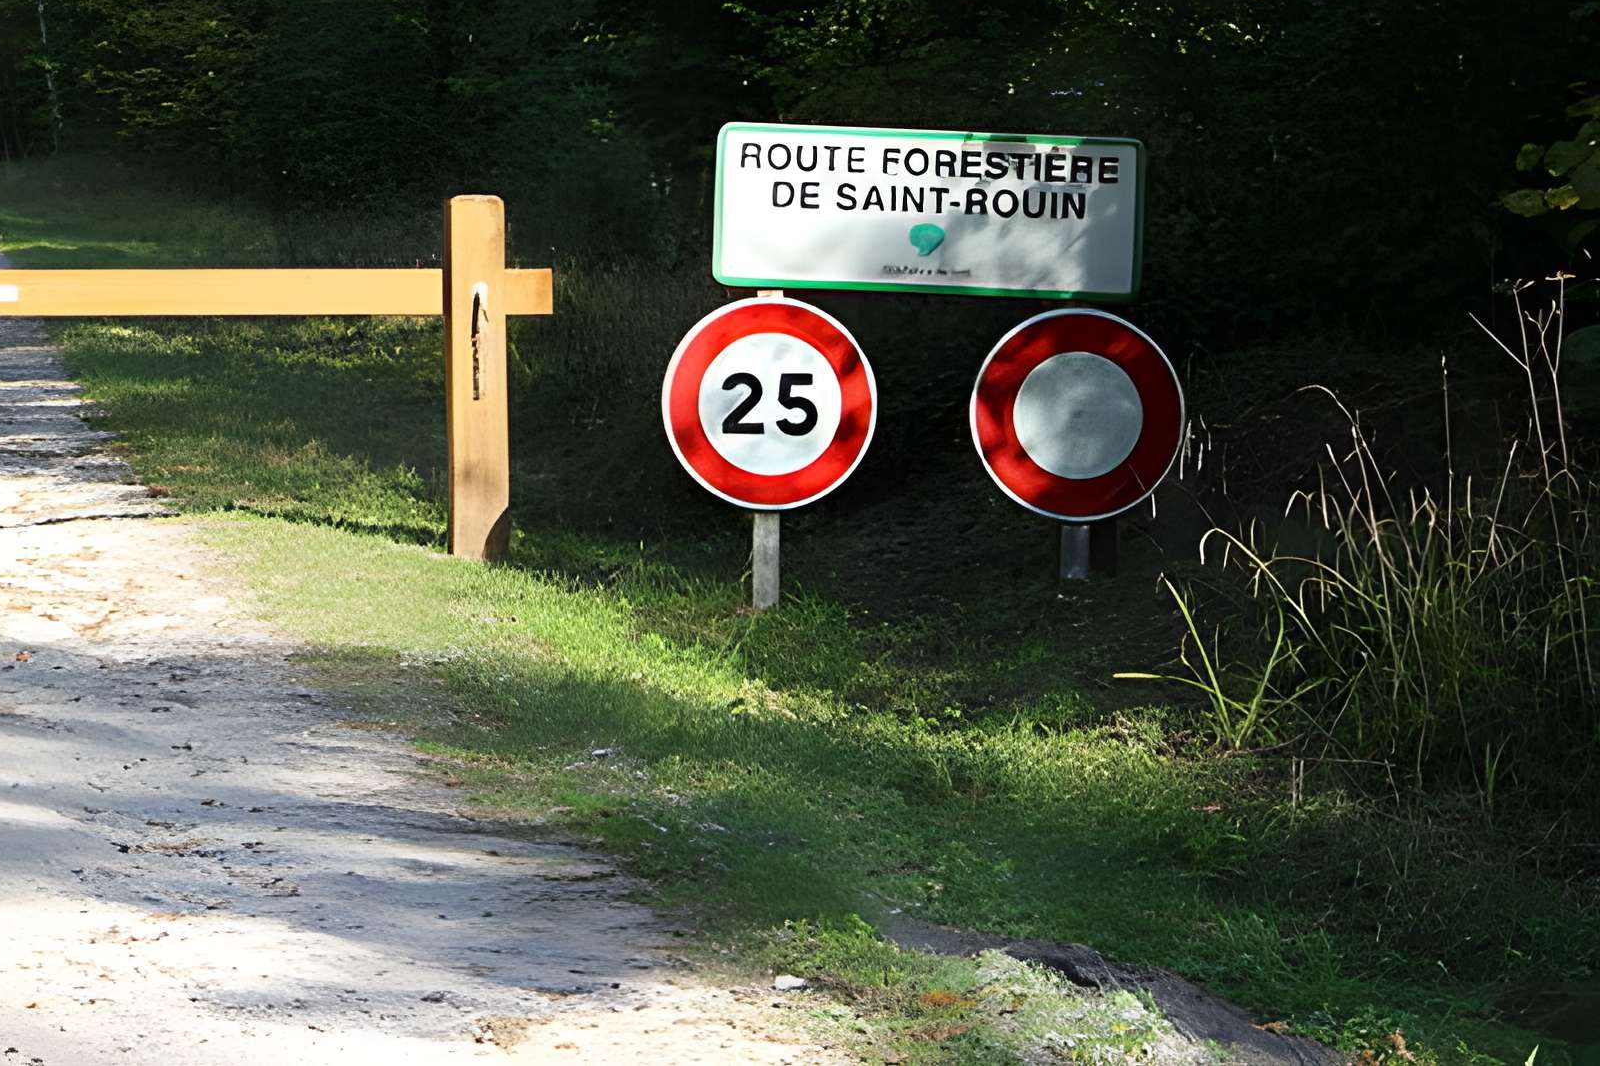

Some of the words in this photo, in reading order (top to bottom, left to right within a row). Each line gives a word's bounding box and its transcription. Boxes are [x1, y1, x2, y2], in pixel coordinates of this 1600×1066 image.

[741, 143, 865, 173] ROUTE
[772, 181, 820, 209] DE
[836, 183, 1086, 219] SAINT-ROUIN
[721, 372, 819, 436] 25
